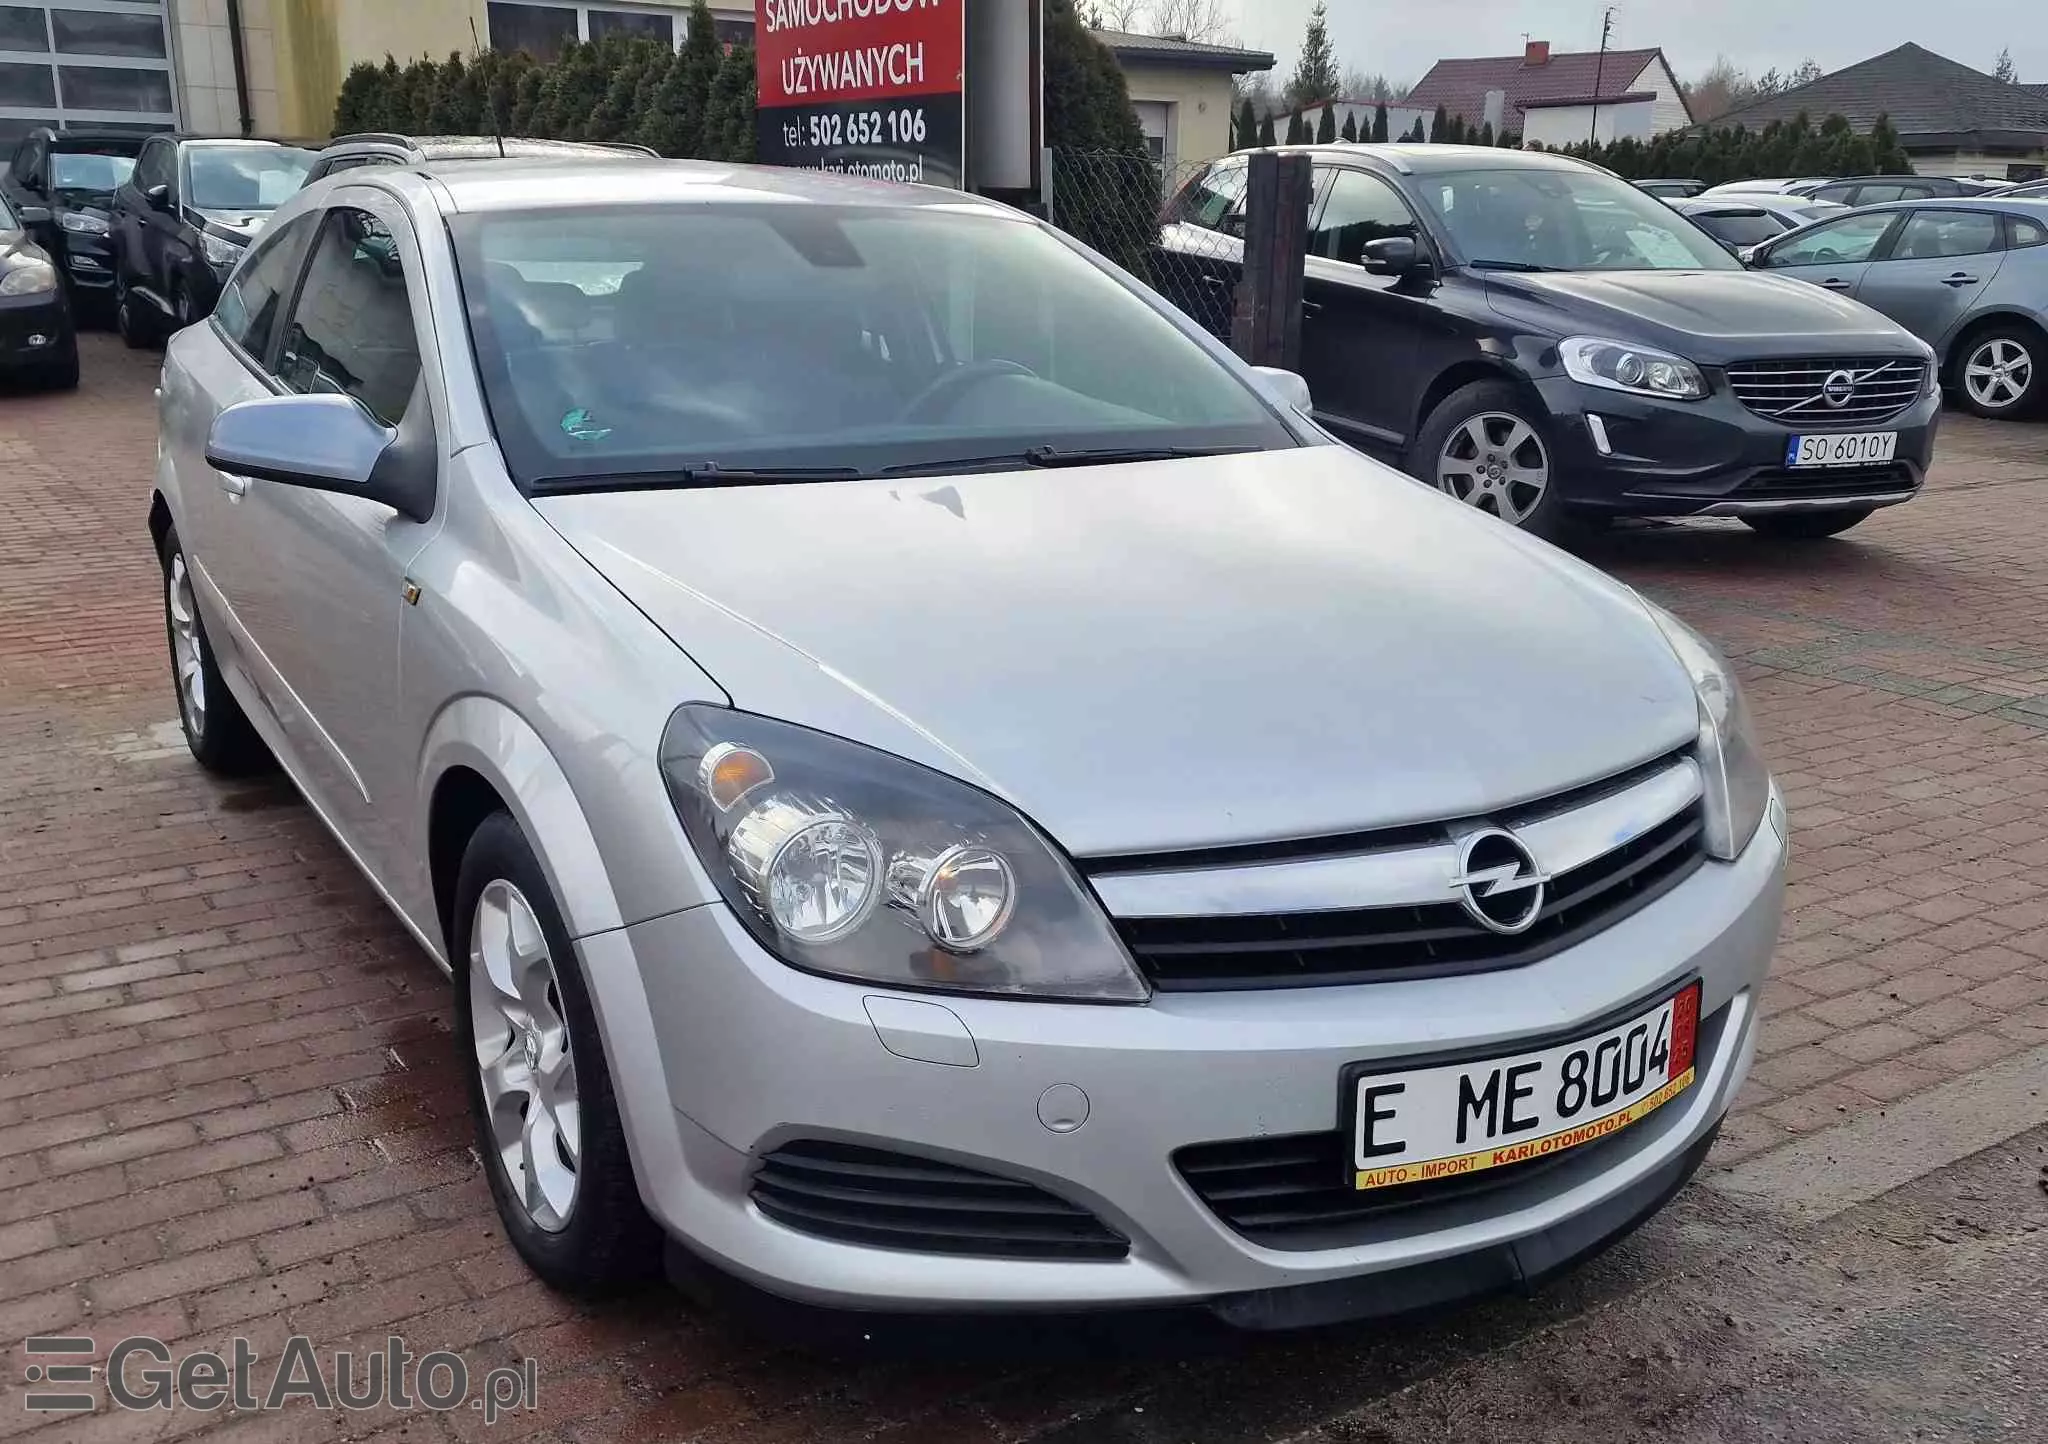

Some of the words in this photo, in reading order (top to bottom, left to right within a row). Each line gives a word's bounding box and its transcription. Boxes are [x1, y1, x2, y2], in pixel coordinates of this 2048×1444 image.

[765, 0, 939, 33] SAMOCH
[781, 41, 925, 95] UŻYWANYCH
[783, 115, 806, 147] tel:
[810, 114, 843, 146] 502
[847, 111, 882, 144] 652
[887, 108, 926, 143] 106
[1802, 438, 1828, 461] SO
[1834, 435, 1892, 460] 6010Y
[1363, 1083, 1406, 1158] E
[1456, 1062, 1542, 1144] ME
[1556, 1008, 1669, 1118] 8004
[1492, 1110, 1633, 1165] KARI.OTOMOTO.PL
[1365, 1168, 1407, 1187] AUTO
[1421, 1157, 1477, 1179] IMPORT
